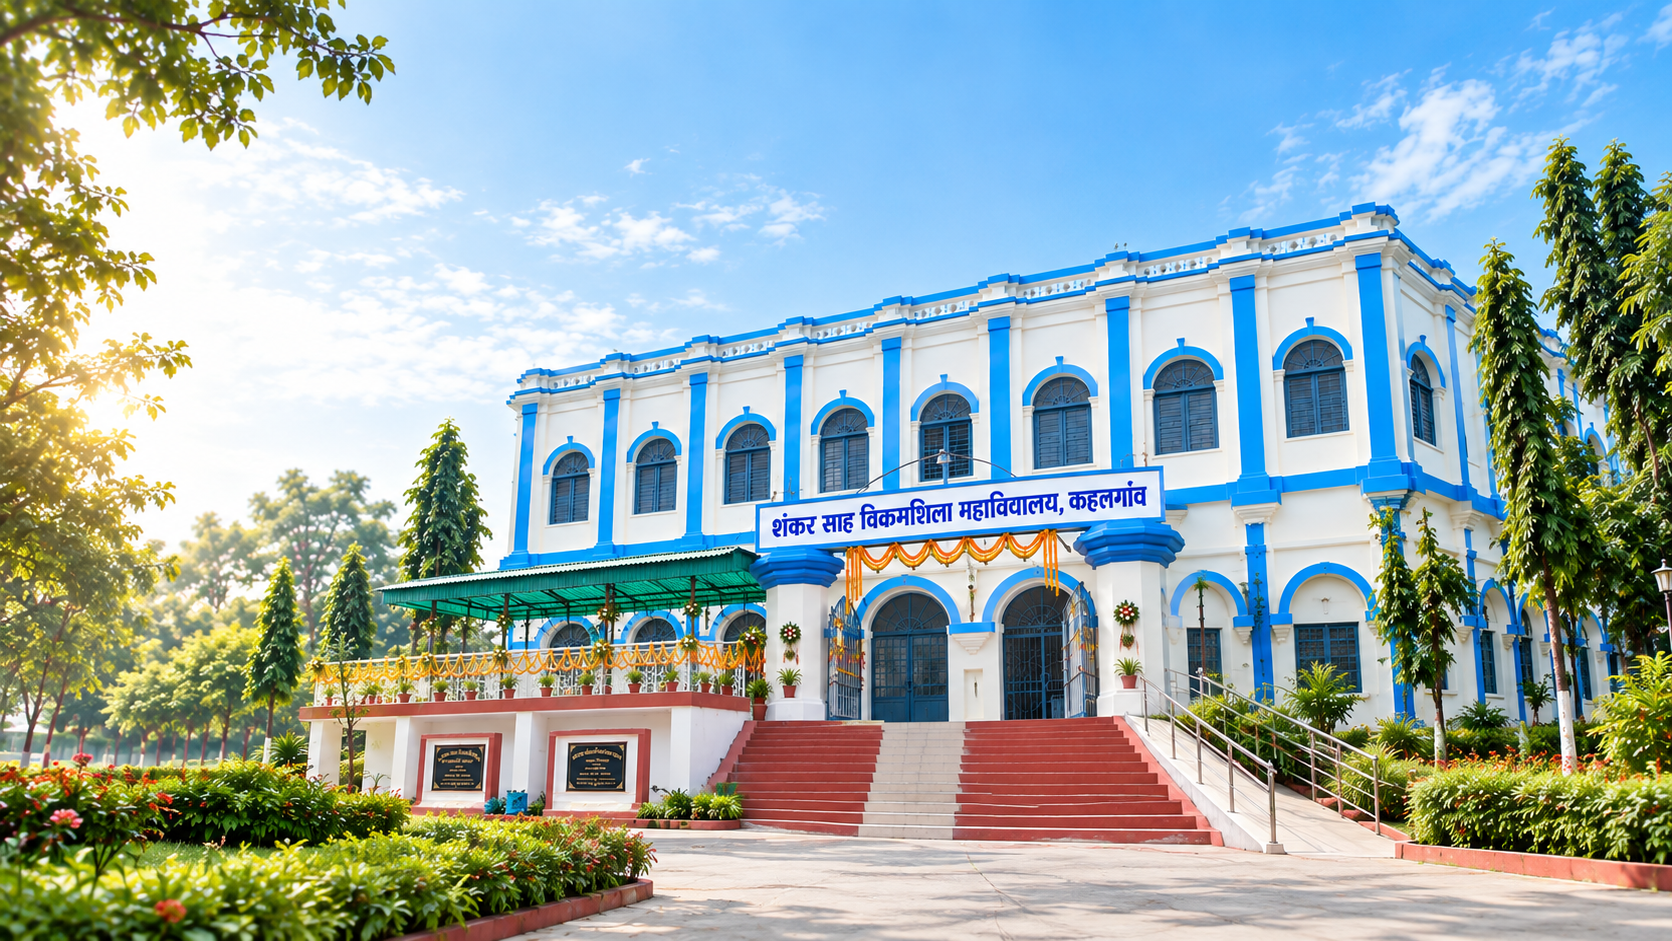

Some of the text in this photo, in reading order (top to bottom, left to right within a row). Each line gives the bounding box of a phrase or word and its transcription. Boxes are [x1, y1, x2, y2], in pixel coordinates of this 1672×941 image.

[772, 513, 817, 537] शंकर
[822, 512, 855, 533] साह
[1068, 480, 1147, 512] कहलगांव
